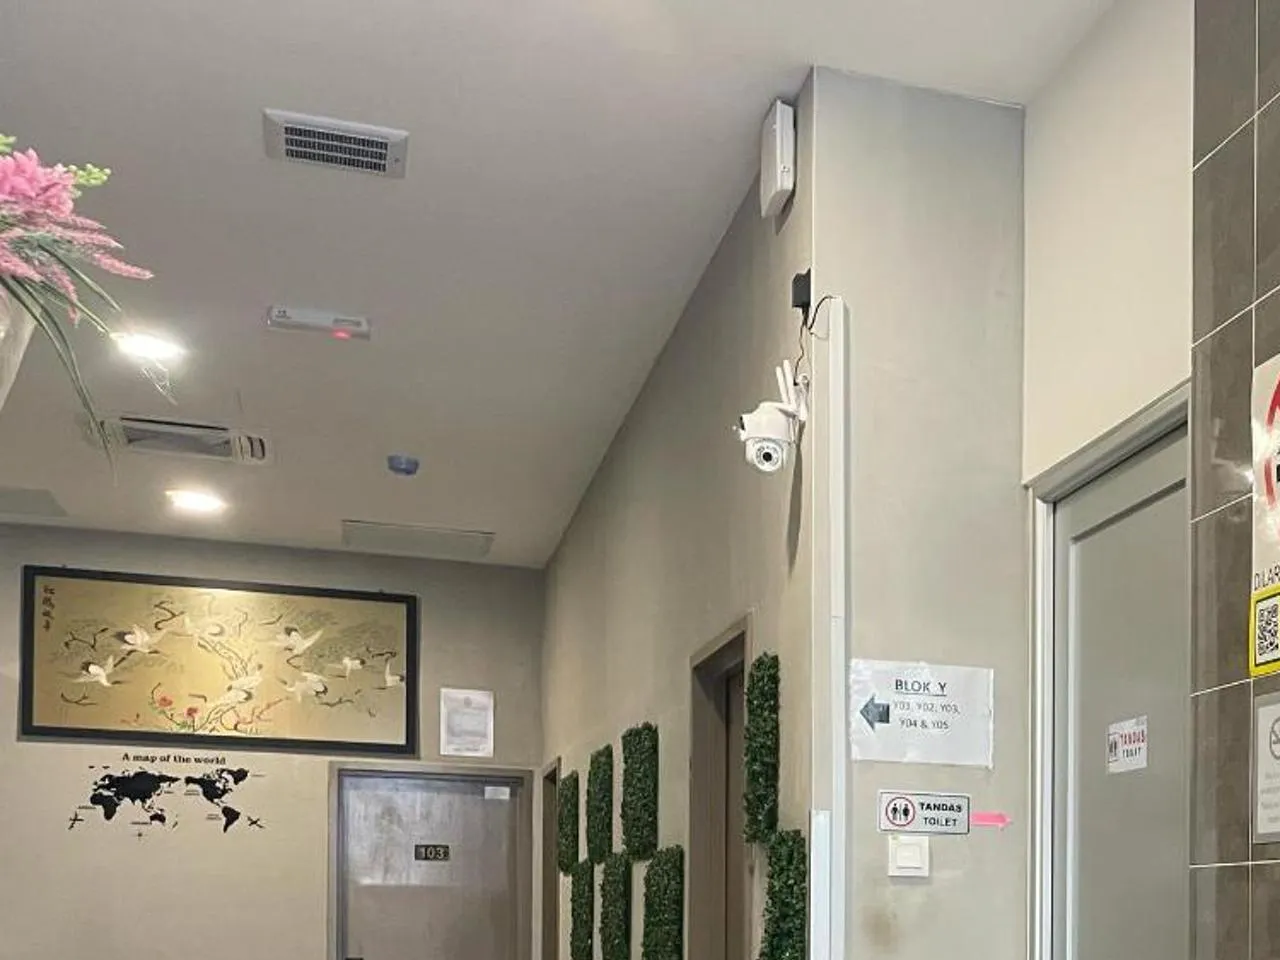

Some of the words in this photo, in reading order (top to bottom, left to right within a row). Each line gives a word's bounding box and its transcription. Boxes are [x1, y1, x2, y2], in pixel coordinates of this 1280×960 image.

[895, 679, 930, 693] BLOK
[938, 681, 947, 693] Y
[122, 752, 129, 761] A
[133, 754, 157, 763] map
[160, 754, 170, 762] of
[174, 754, 192, 763] the
[194, 756, 226, 765] world
[919, 802, 962, 813] TANDAS
[923, 817, 957, 827] TOILET
[421, 847, 444, 859] 103
